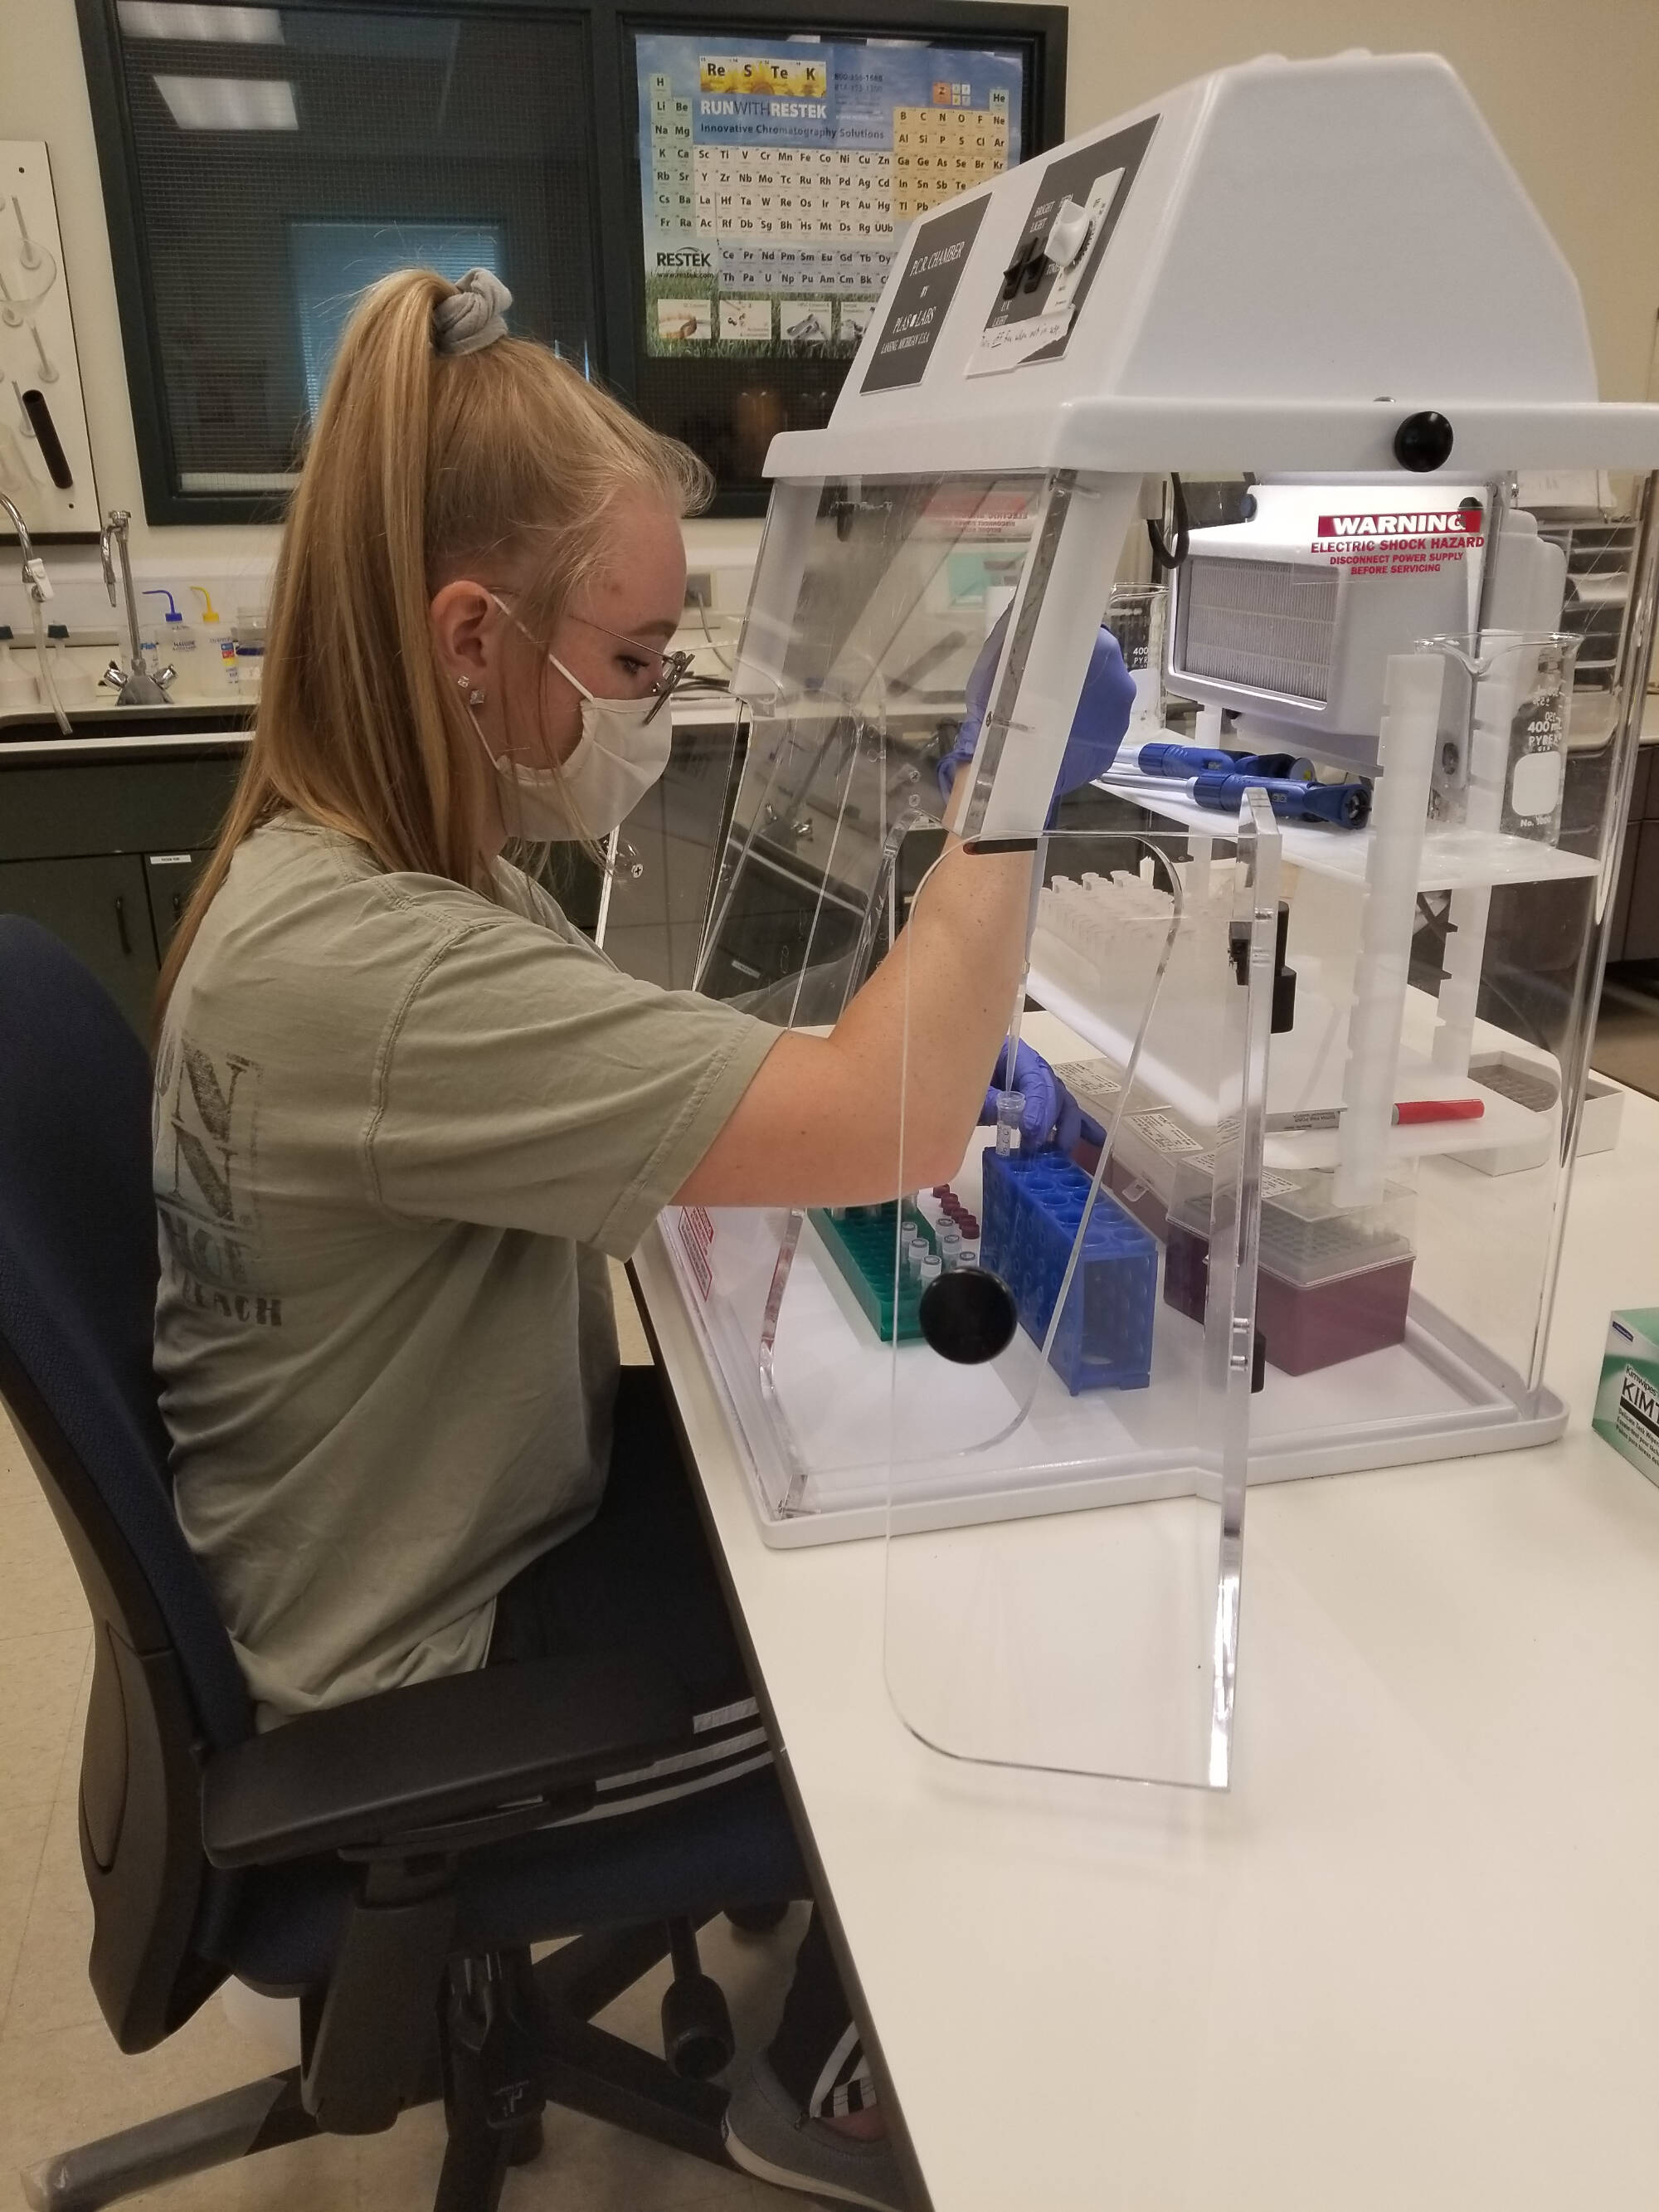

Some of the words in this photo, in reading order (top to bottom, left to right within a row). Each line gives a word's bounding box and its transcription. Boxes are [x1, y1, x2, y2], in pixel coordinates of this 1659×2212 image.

[707, 62, 726, 76] Re
[743, 64, 752, 77] S
[771, 66, 789, 80] Te
[805, 67, 815, 80] K
[656, 77, 664, 86] H
[993, 93, 1005, 103] He
[657, 101, 665, 111] Li
[676, 102, 688, 111] Be
[900, 111, 907, 120] B
[920, 112, 927, 121] C
[939, 113, 946, 122] N
[958, 114, 966, 123] O
[977, 114, 983, 124] F
[994, 116, 1005, 125] Ne
[655, 124, 669, 134] Na
[675, 126, 690, 138] Mg
[701, 124, 753, 134] Innovative
[756, 124, 837, 139] Chromatography
[839, 126, 884, 139] Solutions
[898, 134, 908, 144] Al
[919, 134, 928, 144] Si
[940, 135, 946, 144] P
[959, 136, 965, 145] S
[976, 137, 985, 146] Cl
[994, 138, 1005, 147] Ar
[659, 148, 666, 158] K
[677, 149, 689, 158] Ca
[698, 149, 709, 158] Sc
[742, 150, 748, 160] V
[760, 151, 771, 160] Cr
[778, 152, 793, 161] Mn
[800, 153, 811, 162] Fe
[819, 153, 831, 163] Co
[839, 153, 850, 163] Ni
[859, 155, 870, 164] Cu
[878, 156, 890, 165] Zn
[898, 156, 910, 166] Ga
[917, 157, 930, 167] Ge
[937, 158, 947, 168] As
[956, 158, 966, 168] Se
[975, 160, 985, 168] Br
[994, 160, 1003, 169] Kr
[657, 171, 670, 181] Rb
[679, 172, 689, 181] Sr
[702, 173, 708, 182] Y
[720, 173, 731, 183] Zr
[739, 173, 752, 183] Nb
[758, 174, 773, 183] Mo
[781, 175, 791, 184] Tc
[800, 175, 812, 185] Ru
[820, 176, 831, 185] Rh
[839, 177, 851, 186] Pd
[858, 178, 871, 189] Ag
[878, 178, 890, 188] Cd
[899, 178, 908, 188] In
[917, 180, 929, 188] Sn
[937, 180, 948, 189] Sb
[955, 181, 966, 190] Te
[659, 194, 670, 204] Cs
[679, 195, 691, 204] Ba
[699, 195, 711, 204] La
[721, 196, 732, 205] Hf
[741, 197, 752, 206] Ta
[761, 197, 771, 207] W
[780, 197, 792, 207] Re
[800, 198, 812, 207] Os
[822, 199, 829, 208] Ir
[840, 200, 850, 208] Pt
[858, 200, 871, 209] Au
[878, 201, 890, 212] Hg
[899, 201, 907, 211] Tl
[917, 202, 929, 212] Pb
[660, 217, 670, 227] Fr
[679, 218, 692, 227] Ra
[700, 218, 712, 227] Ac
[722, 218, 732, 228] Rf
[740, 219, 753, 228] Db
[761, 220, 772, 231] Sg
[780, 221, 792, 230] Bh
[800, 221, 812, 231] Hs
[820, 222, 832, 231] Mt
[839, 222, 851, 231] Ds
[859, 223, 871, 234] Rg
[656, 251, 712, 267] RESTEK
[722, 251, 734, 260] Ce
[743, 251, 753, 260] Pr
[761, 251, 775, 261] Nd
[781, 251, 795, 261] Pm
[800, 252, 815, 261] Sm
[821, 253, 833, 261] Eu
[839, 253, 853, 262] Gd
[859, 253, 871, 262] Tb
[878, 254, 891, 265] Dy
[927, 241, 966, 270] CHAMBER
[722, 272, 735, 282] Th
[742, 273, 754, 282] Pa
[765, 273, 771, 283] U
[781, 274, 795, 285] Np
[801, 274, 814, 283] Pu
[820, 275, 834, 284] Am
[839, 275, 854, 284] Cm
[860, 275, 872, 285] Bk
[1332, 514, 1467, 535] WARNING
[1311, 541, 1374, 553] ELECTRIC
[1379, 538, 1426, 551] SHOCK
[1430, 536, 1485, 549] HAZARD
[1330, 554, 1389, 565] DISCONNECT
[1392, 553, 1426, 563] POWER
[1428, 552, 1463, 562] SUPPLY
[1350, 566, 1388, 575] BEFORE
[1390, 564, 1441, 574] SERVICING
[1133, 646, 1148, 655] 400
[1527, 720, 1550, 733] 400
[1625, 1363, 1657, 1397] Kimwipes
